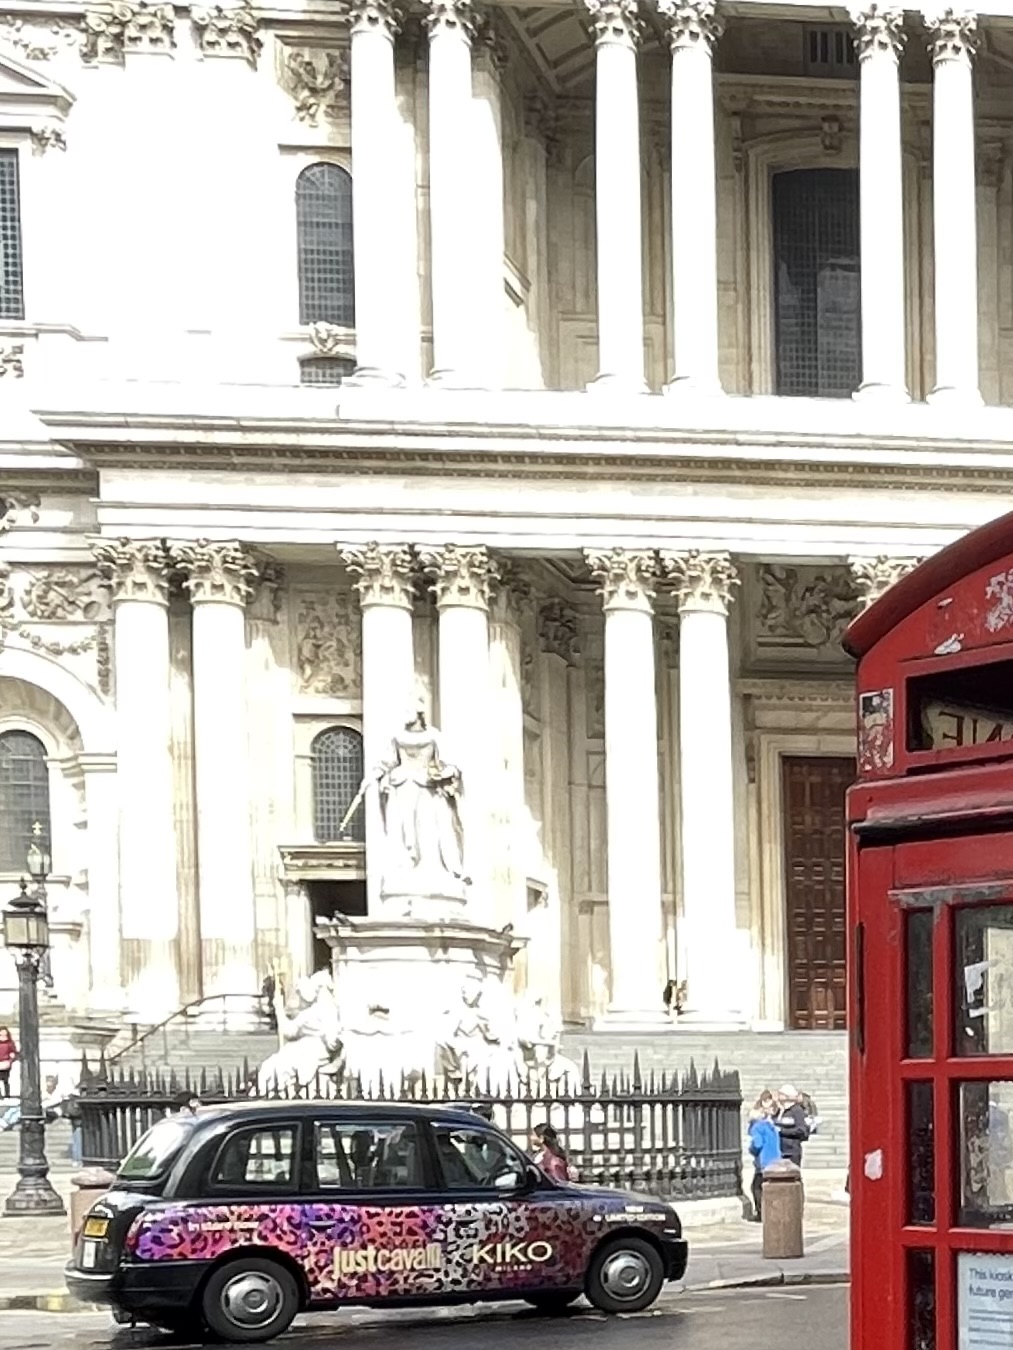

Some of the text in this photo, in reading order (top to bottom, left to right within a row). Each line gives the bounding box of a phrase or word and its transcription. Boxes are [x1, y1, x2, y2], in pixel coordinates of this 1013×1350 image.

[472, 1241, 552, 1264] KIKO
[969, 1268, 986, 1280] This
[969, 1283, 996, 1297] future
